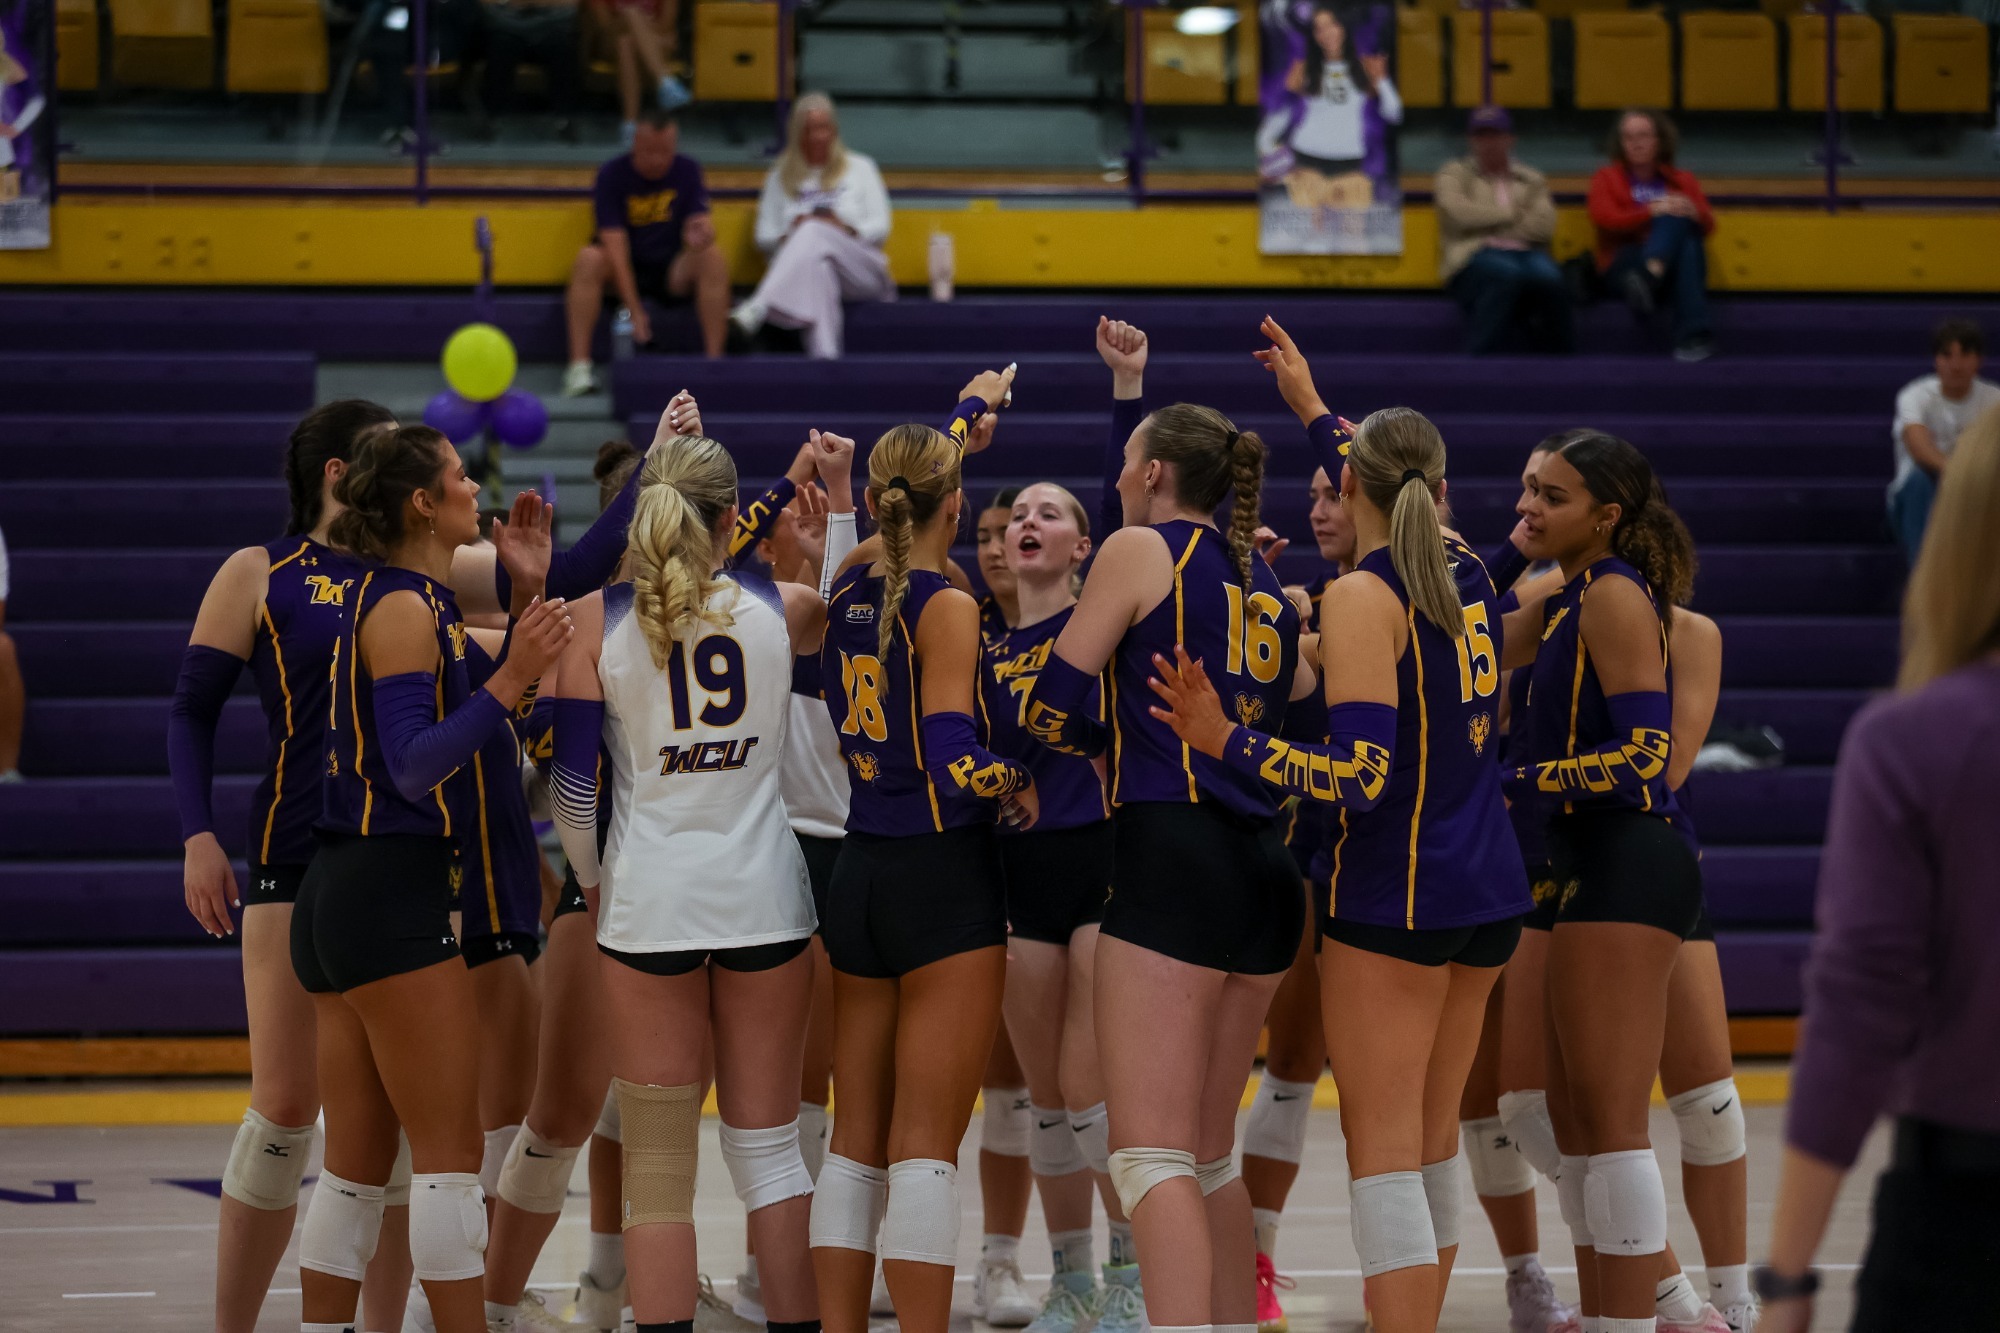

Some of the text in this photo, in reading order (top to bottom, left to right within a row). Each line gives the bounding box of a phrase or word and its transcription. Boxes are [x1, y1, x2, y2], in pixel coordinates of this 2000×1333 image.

[1222, 581, 1284, 684] 16
[1454, 600, 1498, 703] 15
[666, 634, 748, 732] 19
[838, 647, 888, 742] 18
[658, 736, 760, 776] WCU
[1259, 737, 1390, 801] GOLDEN
[1536, 727, 1670, 793] GOLDEN
